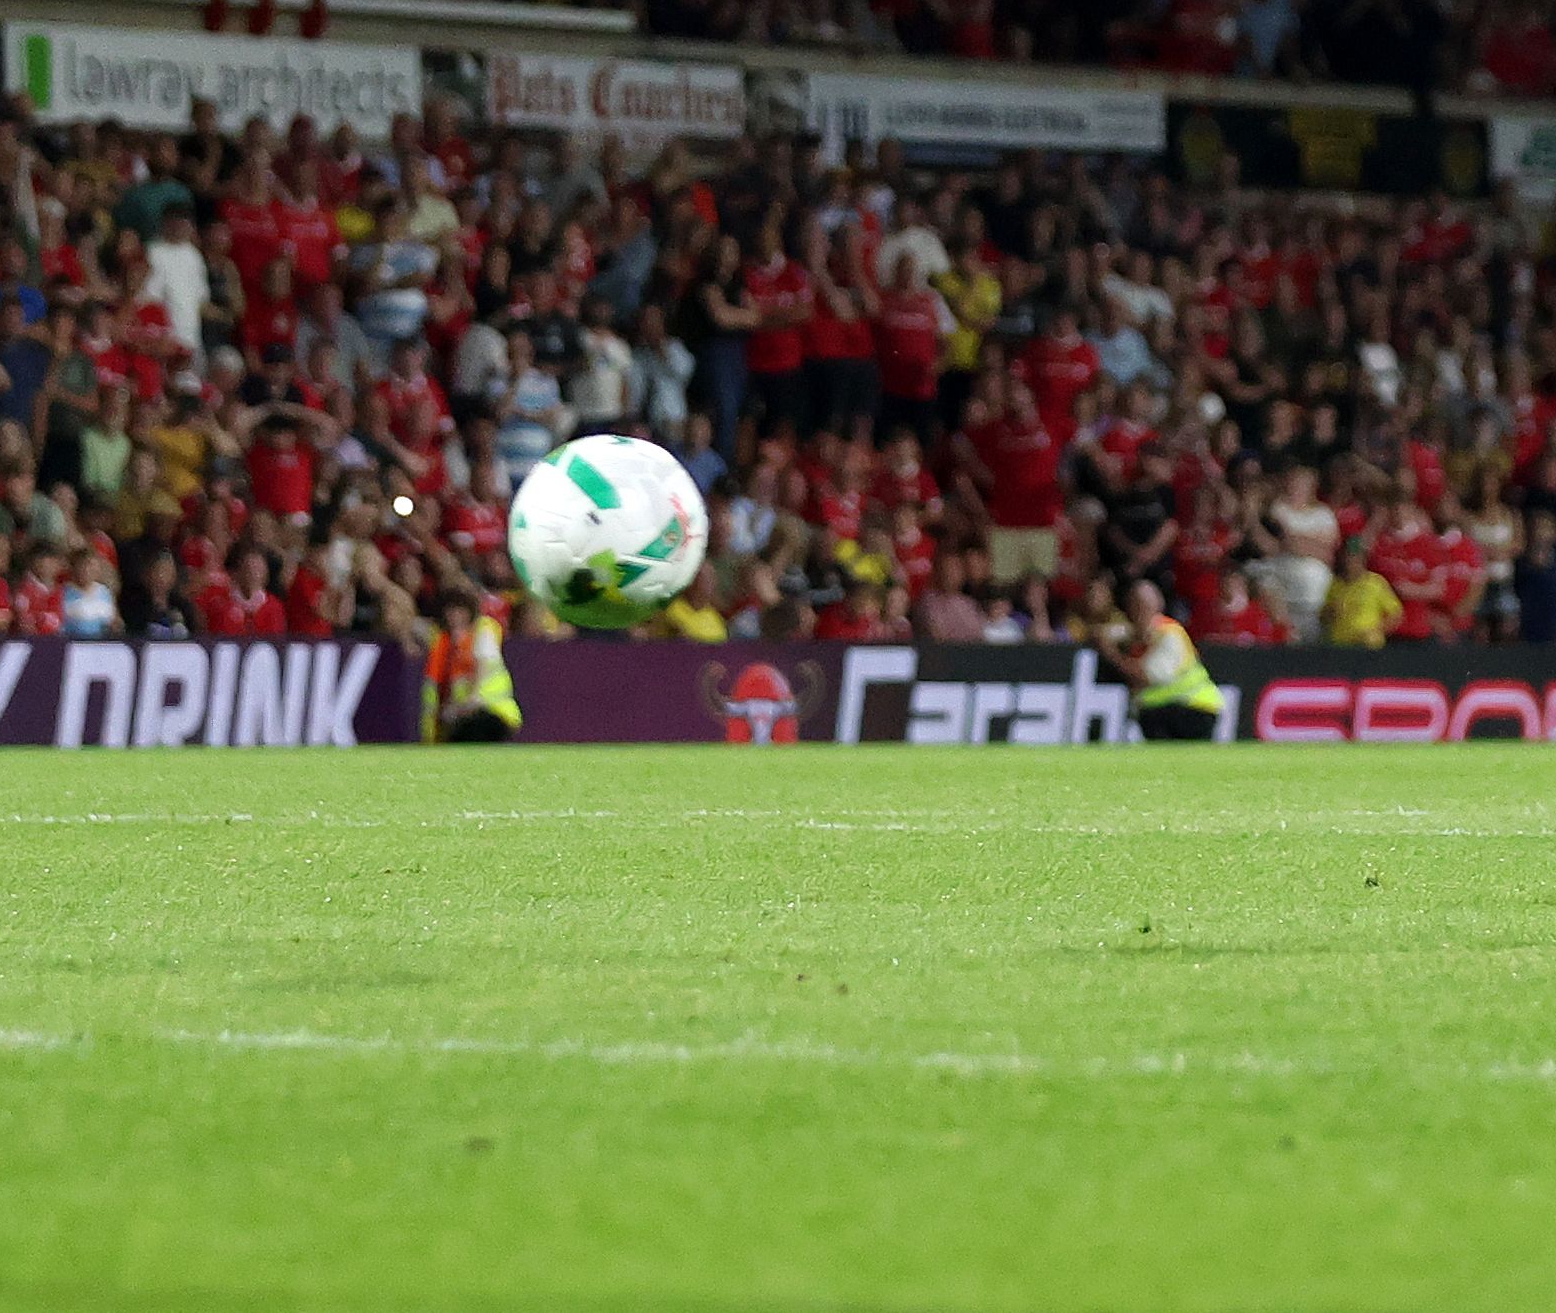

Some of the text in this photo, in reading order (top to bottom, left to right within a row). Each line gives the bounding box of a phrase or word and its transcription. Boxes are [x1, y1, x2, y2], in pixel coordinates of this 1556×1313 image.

[218, 46, 409, 117] architects
[55, 641, 381, 749] DRINK
[837, 645, 1240, 744] Carab
